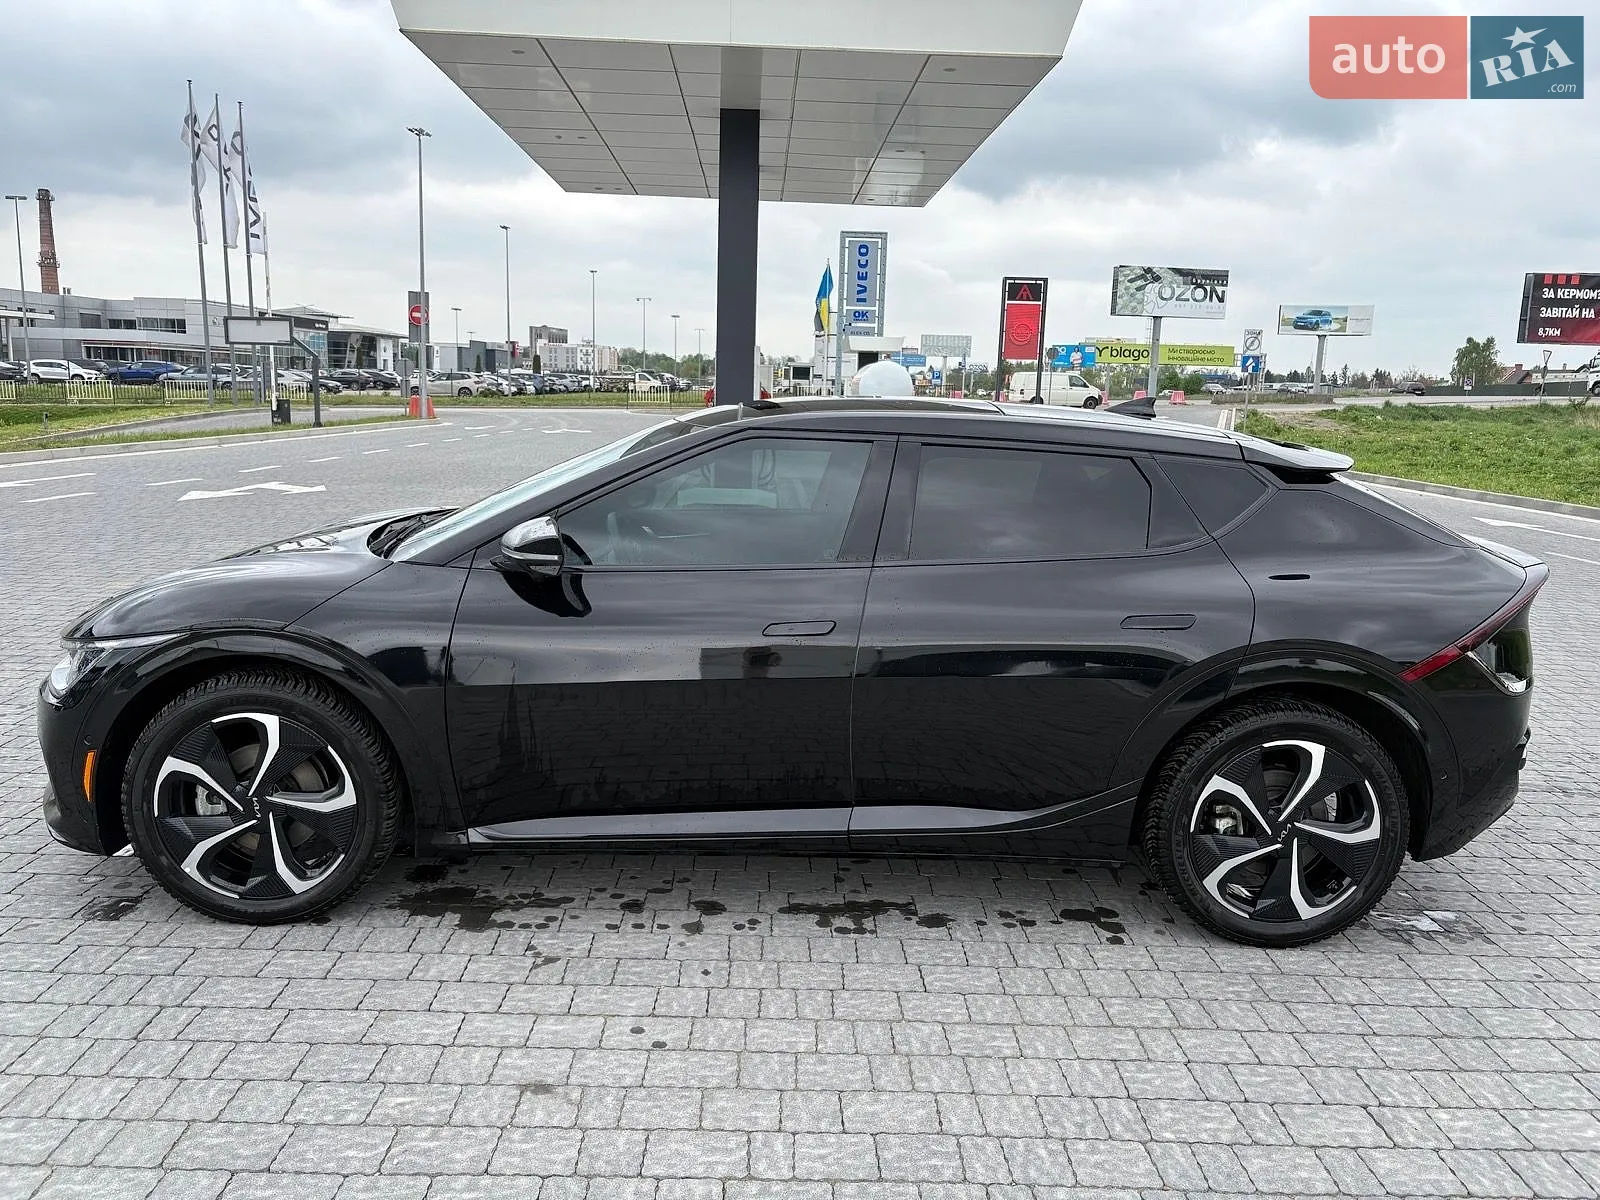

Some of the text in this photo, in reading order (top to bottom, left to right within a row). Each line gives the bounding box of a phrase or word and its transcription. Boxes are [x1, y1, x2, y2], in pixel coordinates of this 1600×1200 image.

[856, 243, 869, 304] IVECO
[1157, 284, 1226, 304] OZON
[1542, 288, 1555, 298] ЗА
[1540, 305, 1595, 318] ЗАВІТАЙ НА
[1110, 346, 1150, 361] blago
